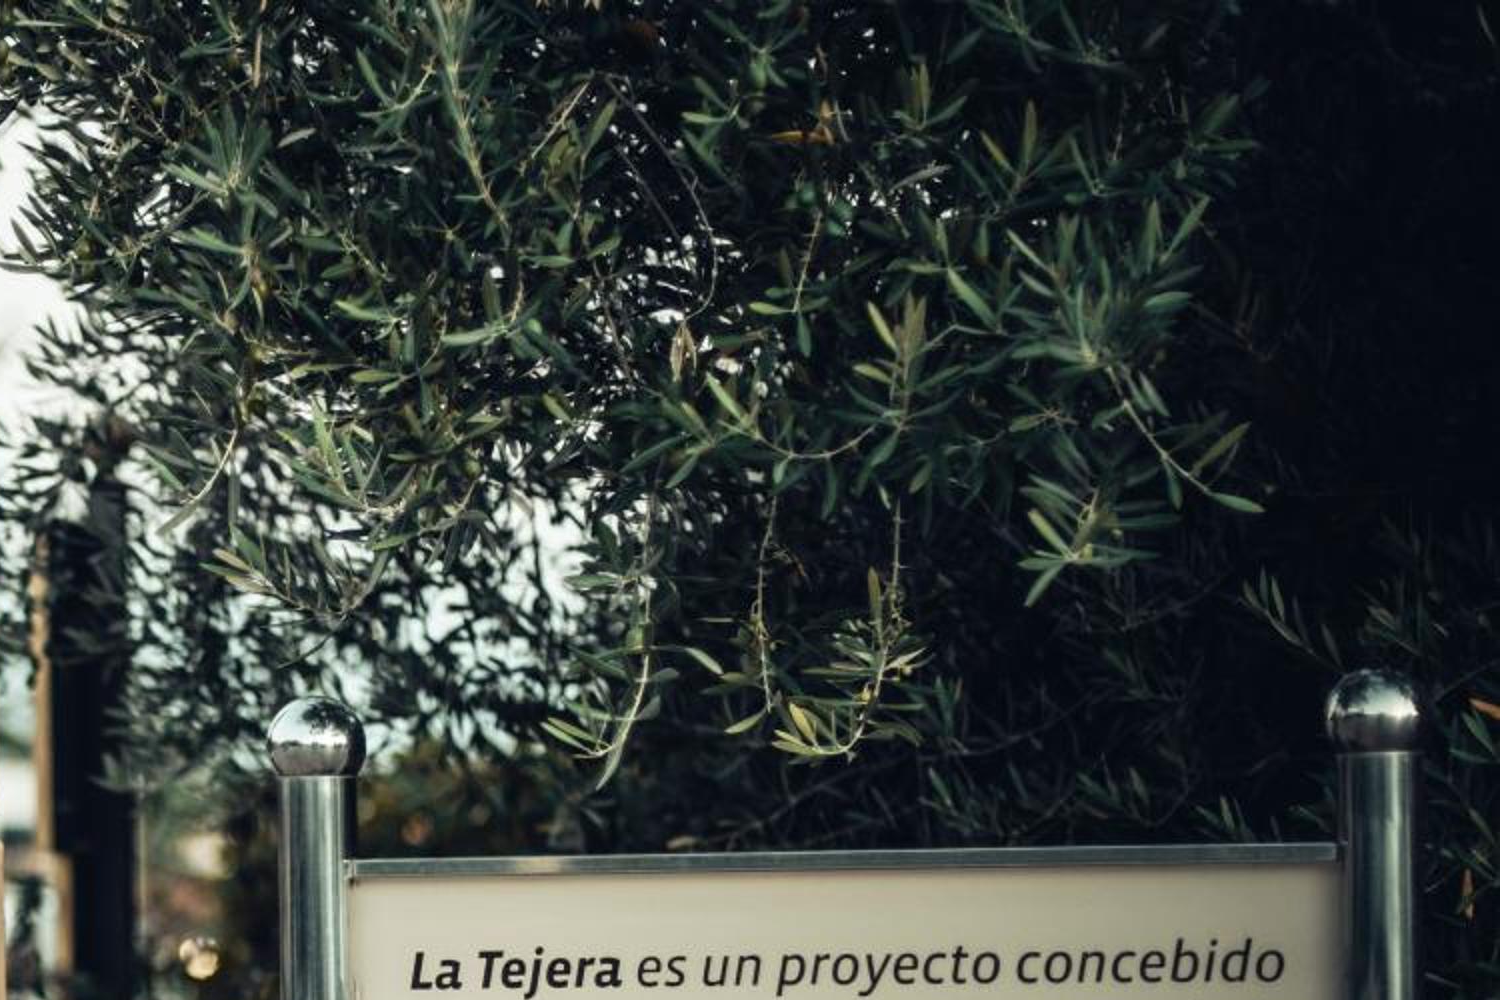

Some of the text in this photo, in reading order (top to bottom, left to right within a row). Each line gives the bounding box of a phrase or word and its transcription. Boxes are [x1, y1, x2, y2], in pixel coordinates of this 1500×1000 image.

[411, 938, 1285, 1000] La Tejera es un proyecto concebido
